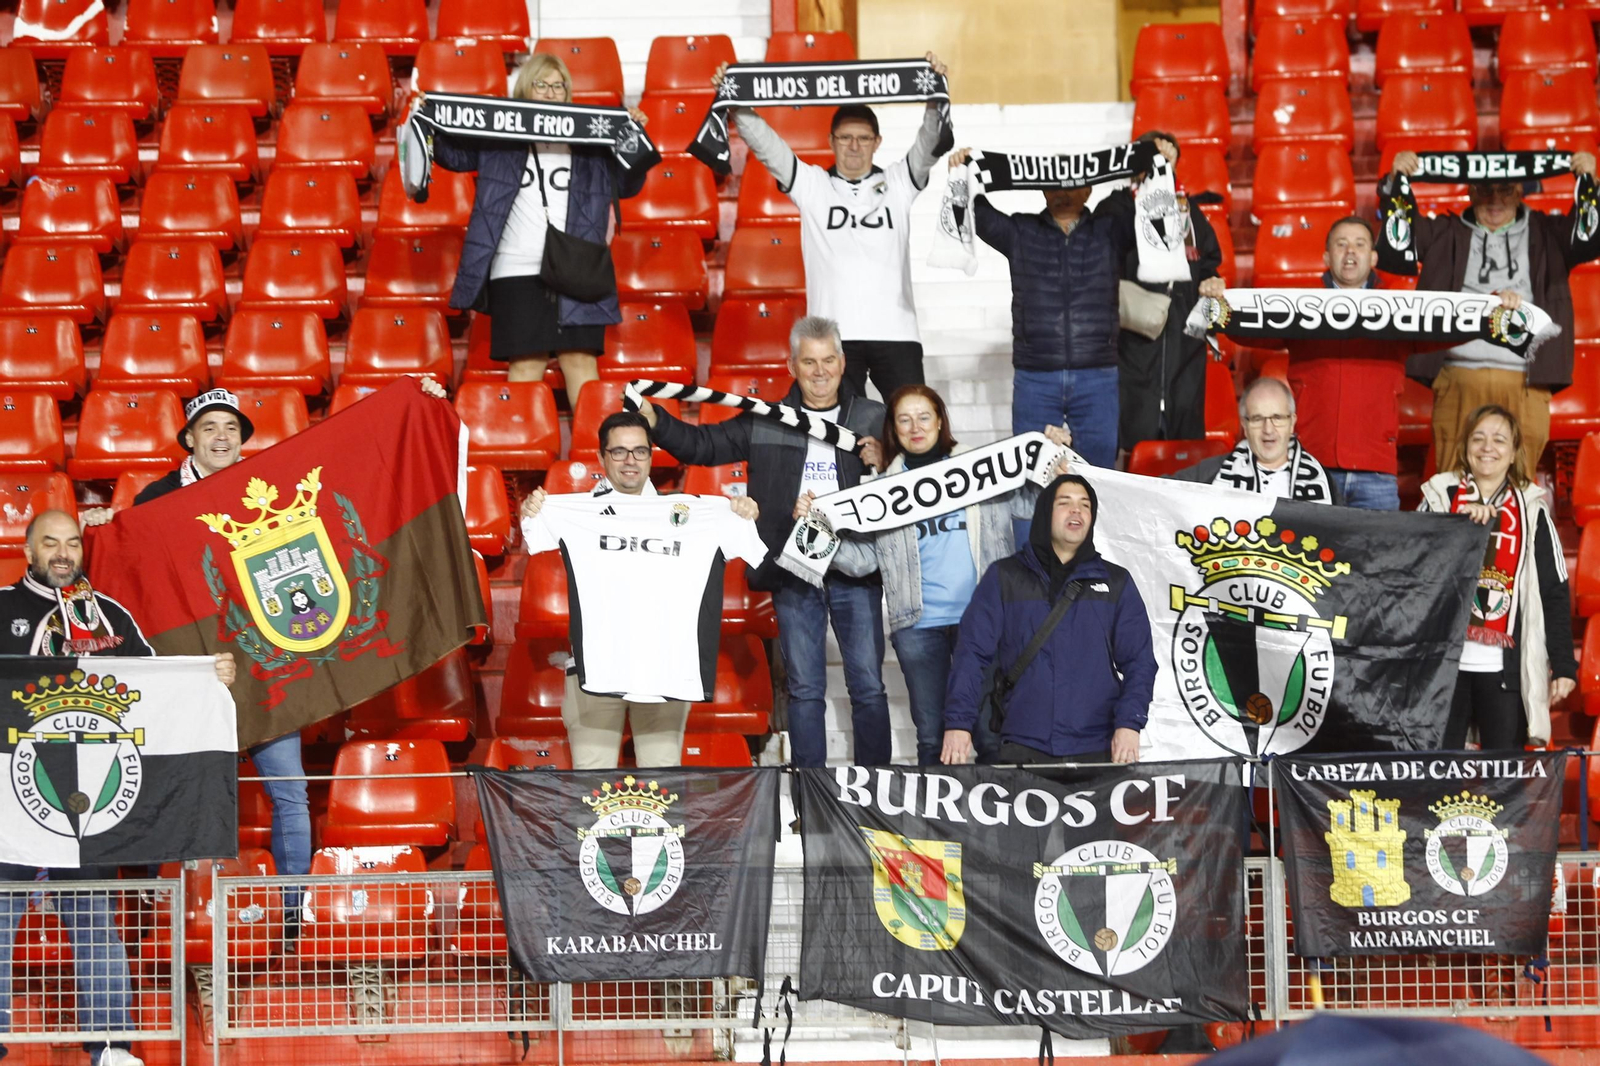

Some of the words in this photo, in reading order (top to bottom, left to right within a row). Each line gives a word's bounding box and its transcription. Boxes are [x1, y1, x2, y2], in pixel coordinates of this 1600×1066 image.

[753, 75, 810, 98] HIJOS
[816, 75, 851, 97] DEL
[858, 73, 901, 95] FRIO
[434, 103, 487, 129] HIJOS
[493, 110, 526, 133] DEL
[533, 113, 576, 137] FRIO
[1007, 152, 1100, 181] BURGOS
[1467, 154, 1526, 179] DEL
[826, 205, 894, 230] DIGI
[207, 392, 228, 402] VIDA
[599, 534, 682, 557] DIGI
[1228, 583, 1287, 609] CLUB
[1180, 622, 1222, 728] BURGOS
[1294, 650, 1330, 737] FUTBOL
[53, 715, 100, 731] CLUB
[1290, 761, 1388, 782] CABEZA
[1391, 760, 1425, 781] DE
[1429, 759, 1548, 780] CASTILLA
[16, 750, 52, 821] BURGOS
[107, 754, 139, 819] FUTBOL
[834, 764, 1098, 828] BURGOS
[1109, 773, 1187, 826] CF
[609, 811, 653, 827] CLUB
[1449, 817, 1483, 829] CLUB
[1077, 843, 1134, 863] CLUB
[1427, 841, 1454, 889] BURGOS
[1486, 839, 1507, 887] FUTBOL
[582, 843, 615, 906] BURGOS
[651, 840, 682, 903] FUTBOL
[1038, 881, 1082, 963] BURGOS
[1132, 878, 1173, 960] FUTBOL
[1357, 909, 1448, 927] BURGOS
[1451, 909, 1480, 924] CF
[546, 932, 723, 955] KARABANCHEL
[1349, 928, 1496, 948] KARABANCHEL
[871, 971, 987, 1007] CAPUT
